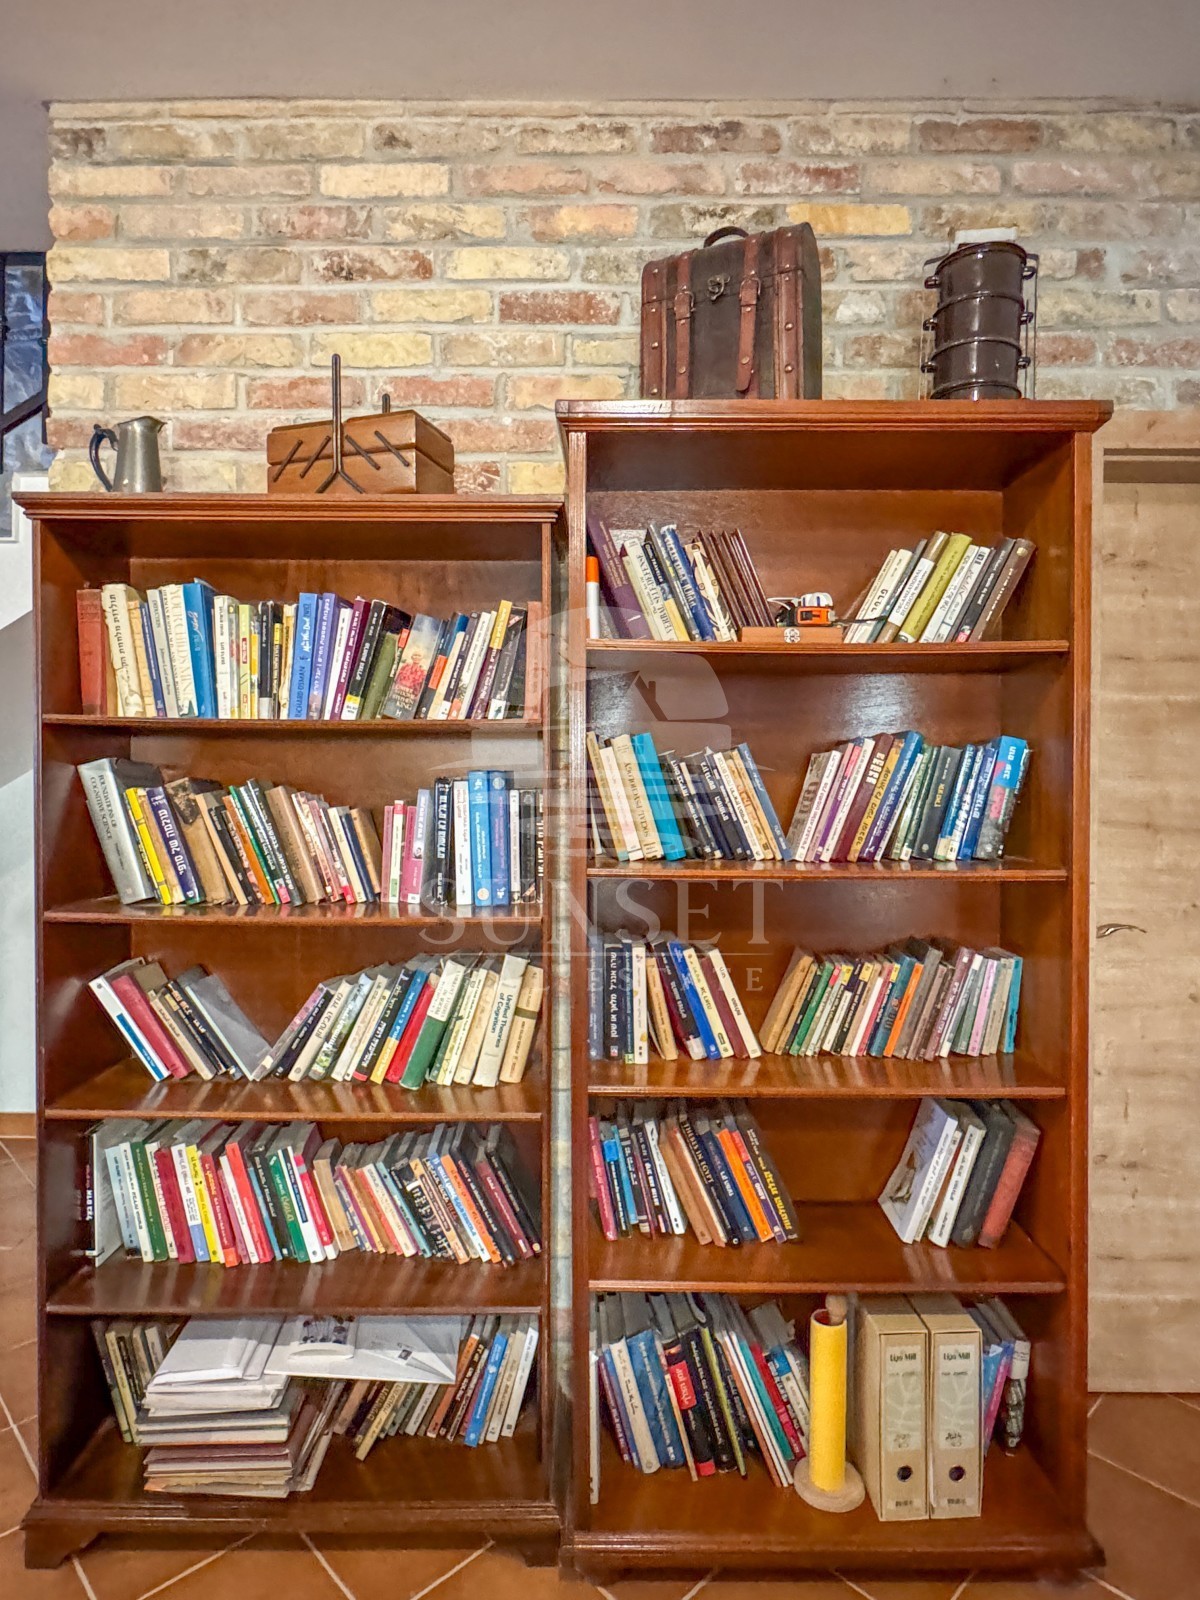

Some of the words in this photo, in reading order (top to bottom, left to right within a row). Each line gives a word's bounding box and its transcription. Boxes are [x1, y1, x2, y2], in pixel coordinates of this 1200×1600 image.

[895, 568, 922, 613] ORGANIZATIONAL
[151, 599, 161, 629] DEDUCTION
[655, 603, 673, 633] VERBAL
[298, 666, 306, 690] OSMAN
[294, 690, 304, 717] RICHARD
[1007, 745, 1016, 760] תום
[624, 761, 645, 809] PSYCHOLOGY
[878, 767, 891, 790] שמואל
[90, 777, 104, 814] COGNITIVE
[101, 813, 113, 840] SCIENCE
[98, 774, 116, 819] FOUNDATIONS
[158, 809, 175, 837] עולמה
[437, 819, 446, 829] לא
[639, 809, 649, 837] SOCIAL
[169, 839, 180, 854] של
[173, 855, 187, 876] סופי
[498, 992, 505, 1000] of
[502, 994, 513, 1018] Unified
[609, 993, 617, 1011] מלאך
[490, 1000, 503, 1033] Cognition
[495, 1019, 506, 1048] Theories
[683, 1122, 699, 1149] THEBES
[695, 1150, 703, 1160] IN
[699, 1160, 714, 1183] EGYPT
[762, 1169, 778, 1195] קבלת
[774, 1196, 792, 1230] החלטות
